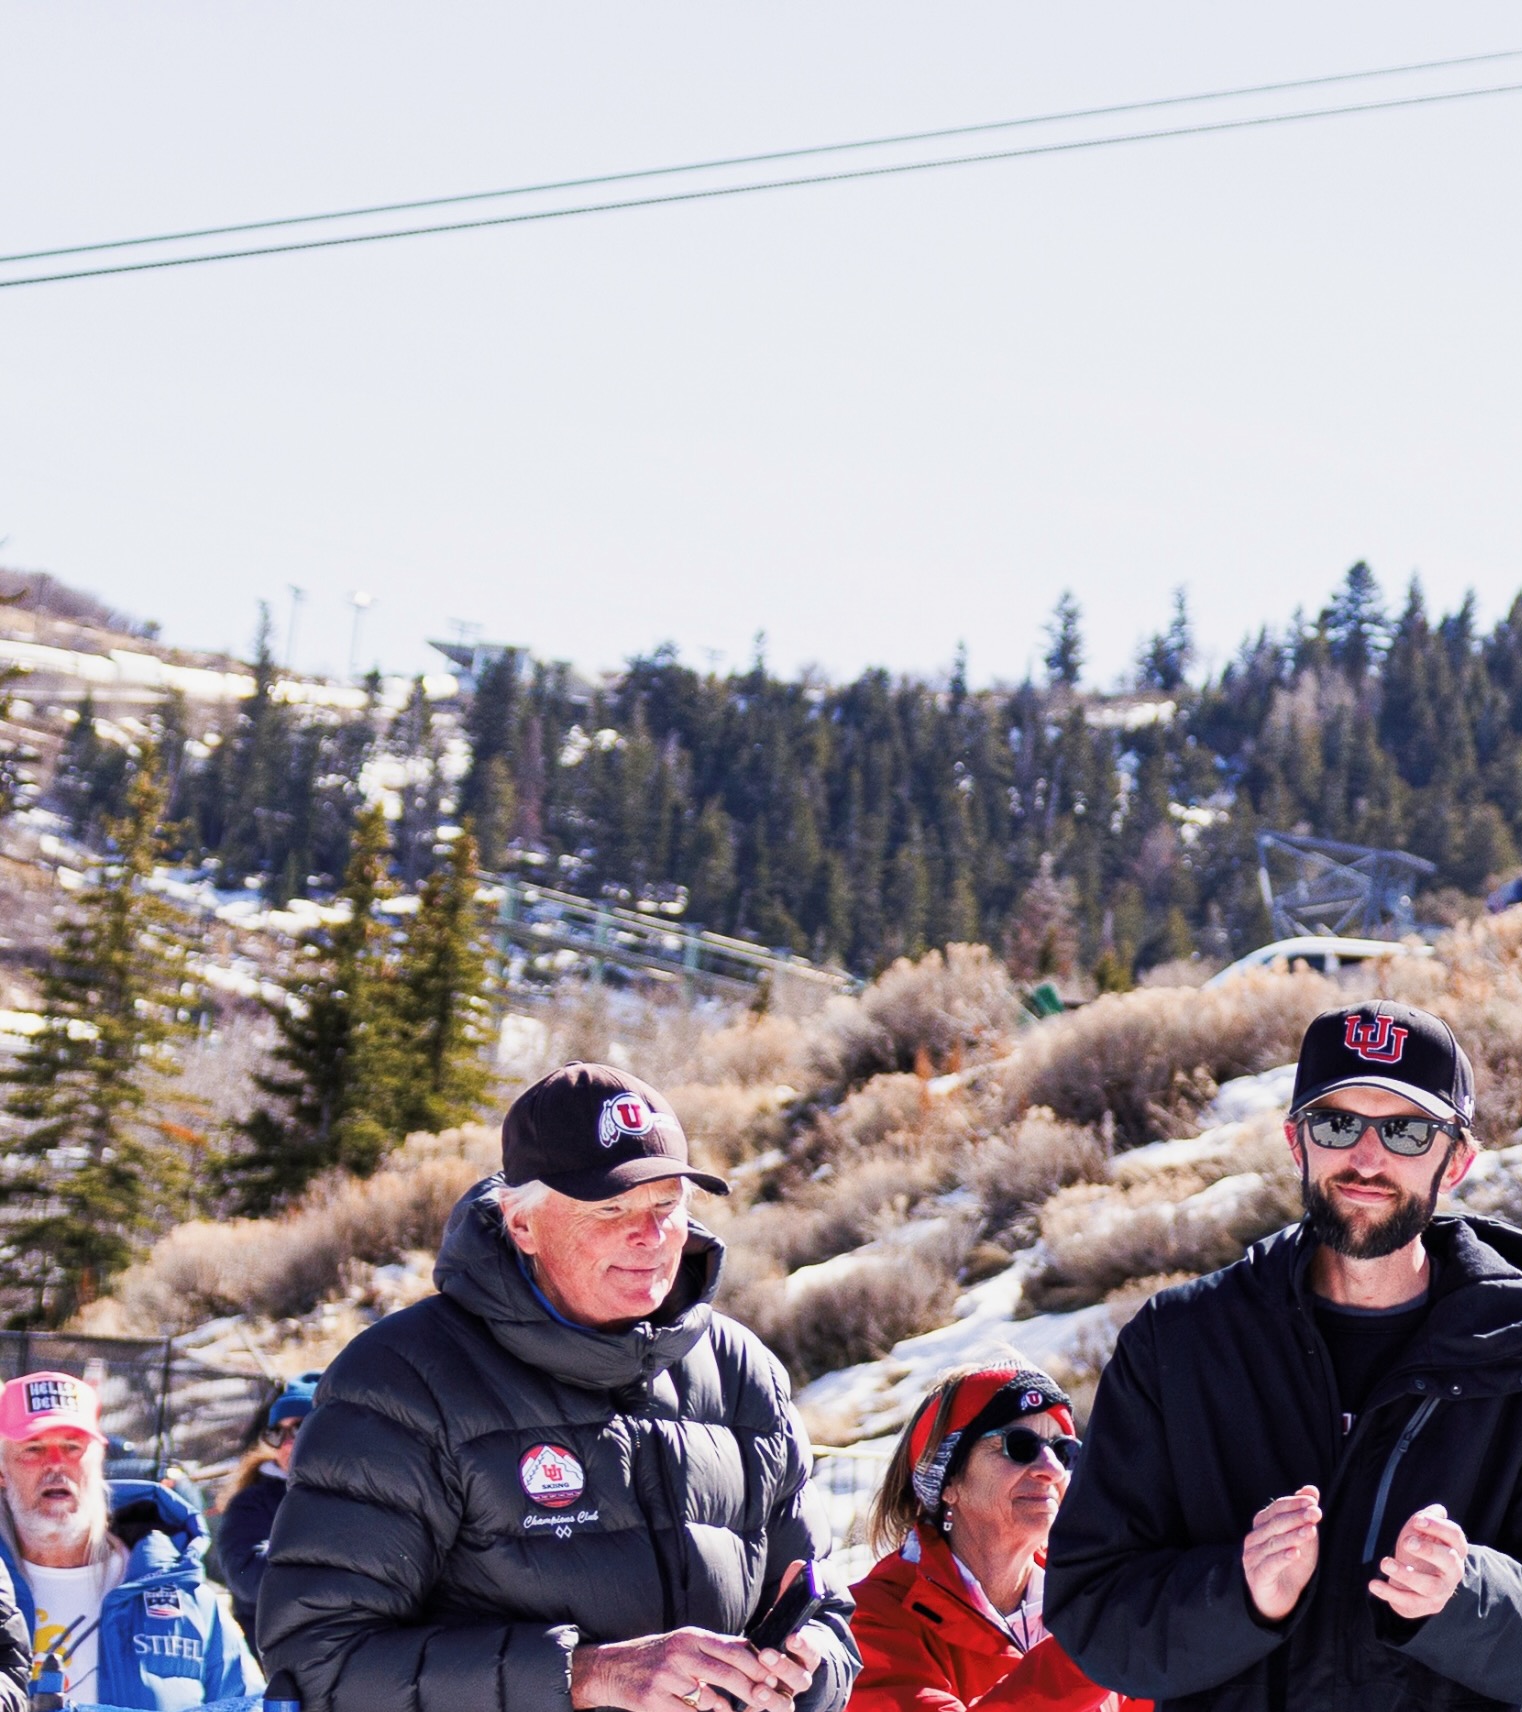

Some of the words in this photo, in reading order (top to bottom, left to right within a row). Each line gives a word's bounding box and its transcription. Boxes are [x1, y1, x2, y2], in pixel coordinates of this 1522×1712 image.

[541, 1482, 570, 1490] SKIING
[523, 1514, 576, 1529] Champions
[577, 1510, 599, 1524] Club
